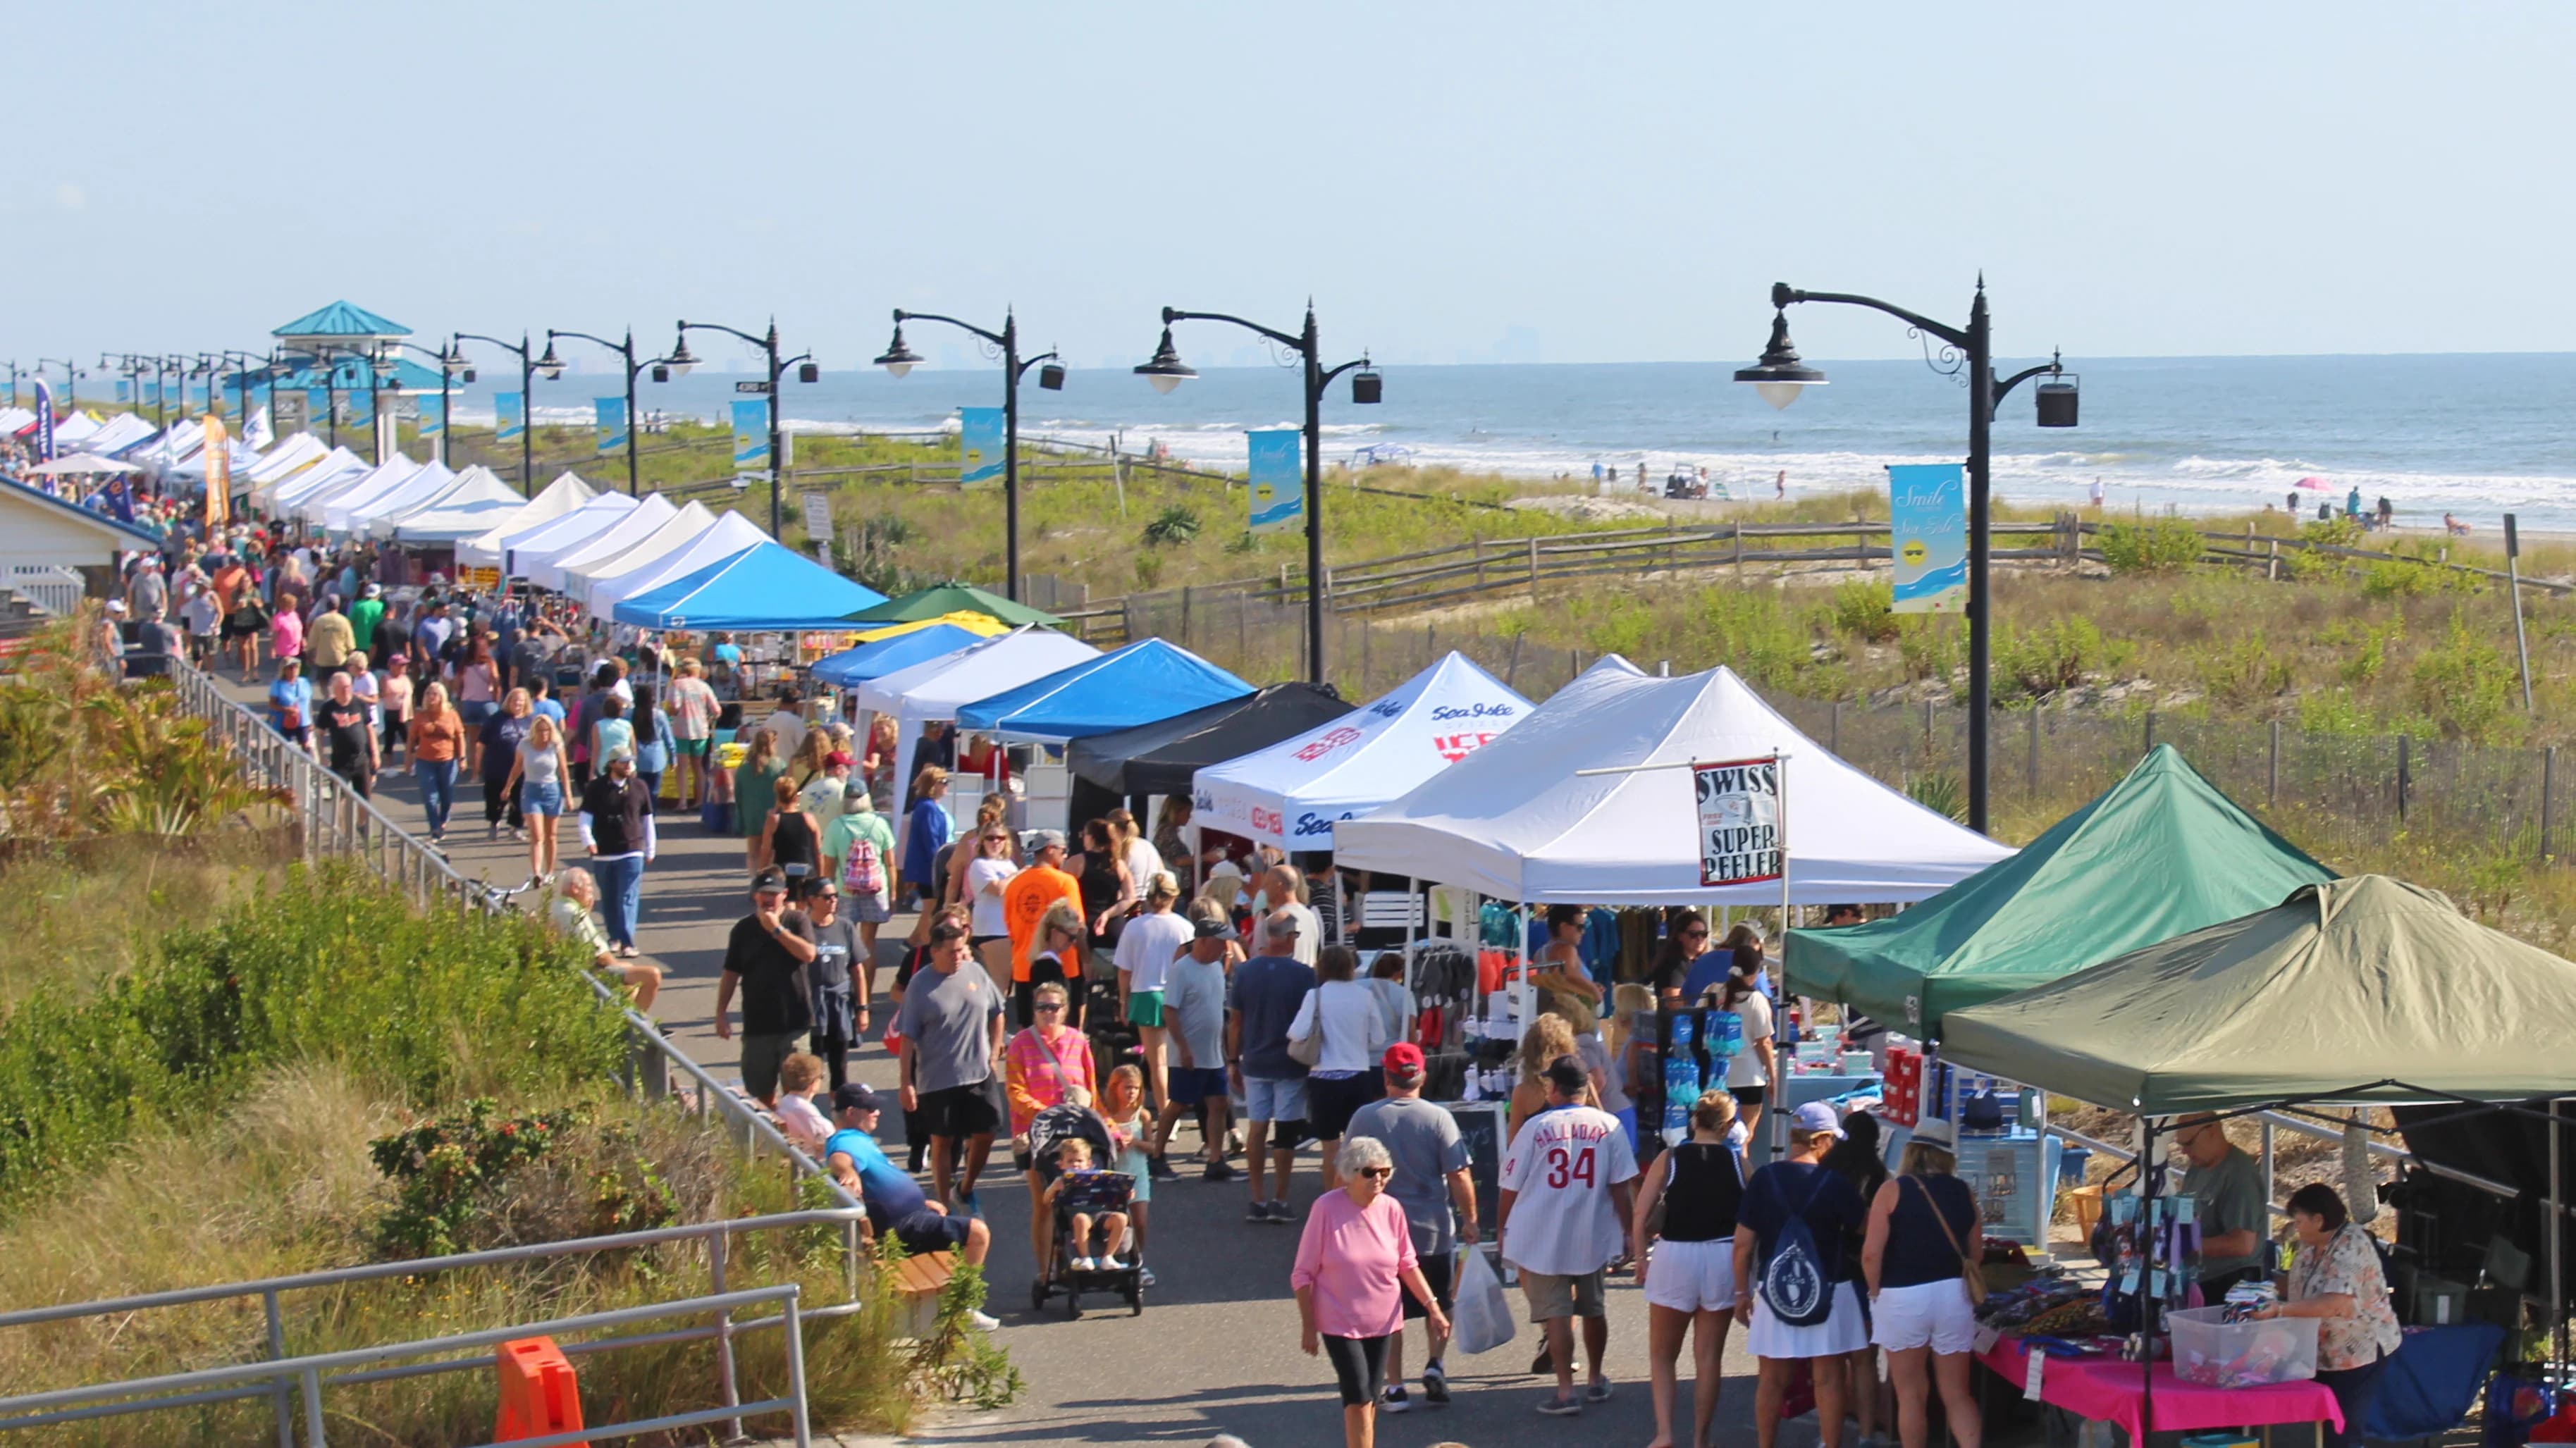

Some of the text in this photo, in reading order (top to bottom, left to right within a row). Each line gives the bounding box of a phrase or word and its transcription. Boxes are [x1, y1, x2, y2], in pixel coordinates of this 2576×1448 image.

[1894, 479, 1958, 507] Smile
[1432, 703, 1515, 721] Sea Isle
[1696, 765, 1776, 804] SWISS
[1711, 824, 1774, 855] SUPER
[1703, 850, 1780, 881] PEELER
[1534, 1123, 1608, 1149] HALLADAY
[1548, 1147, 1596, 1189] 34
